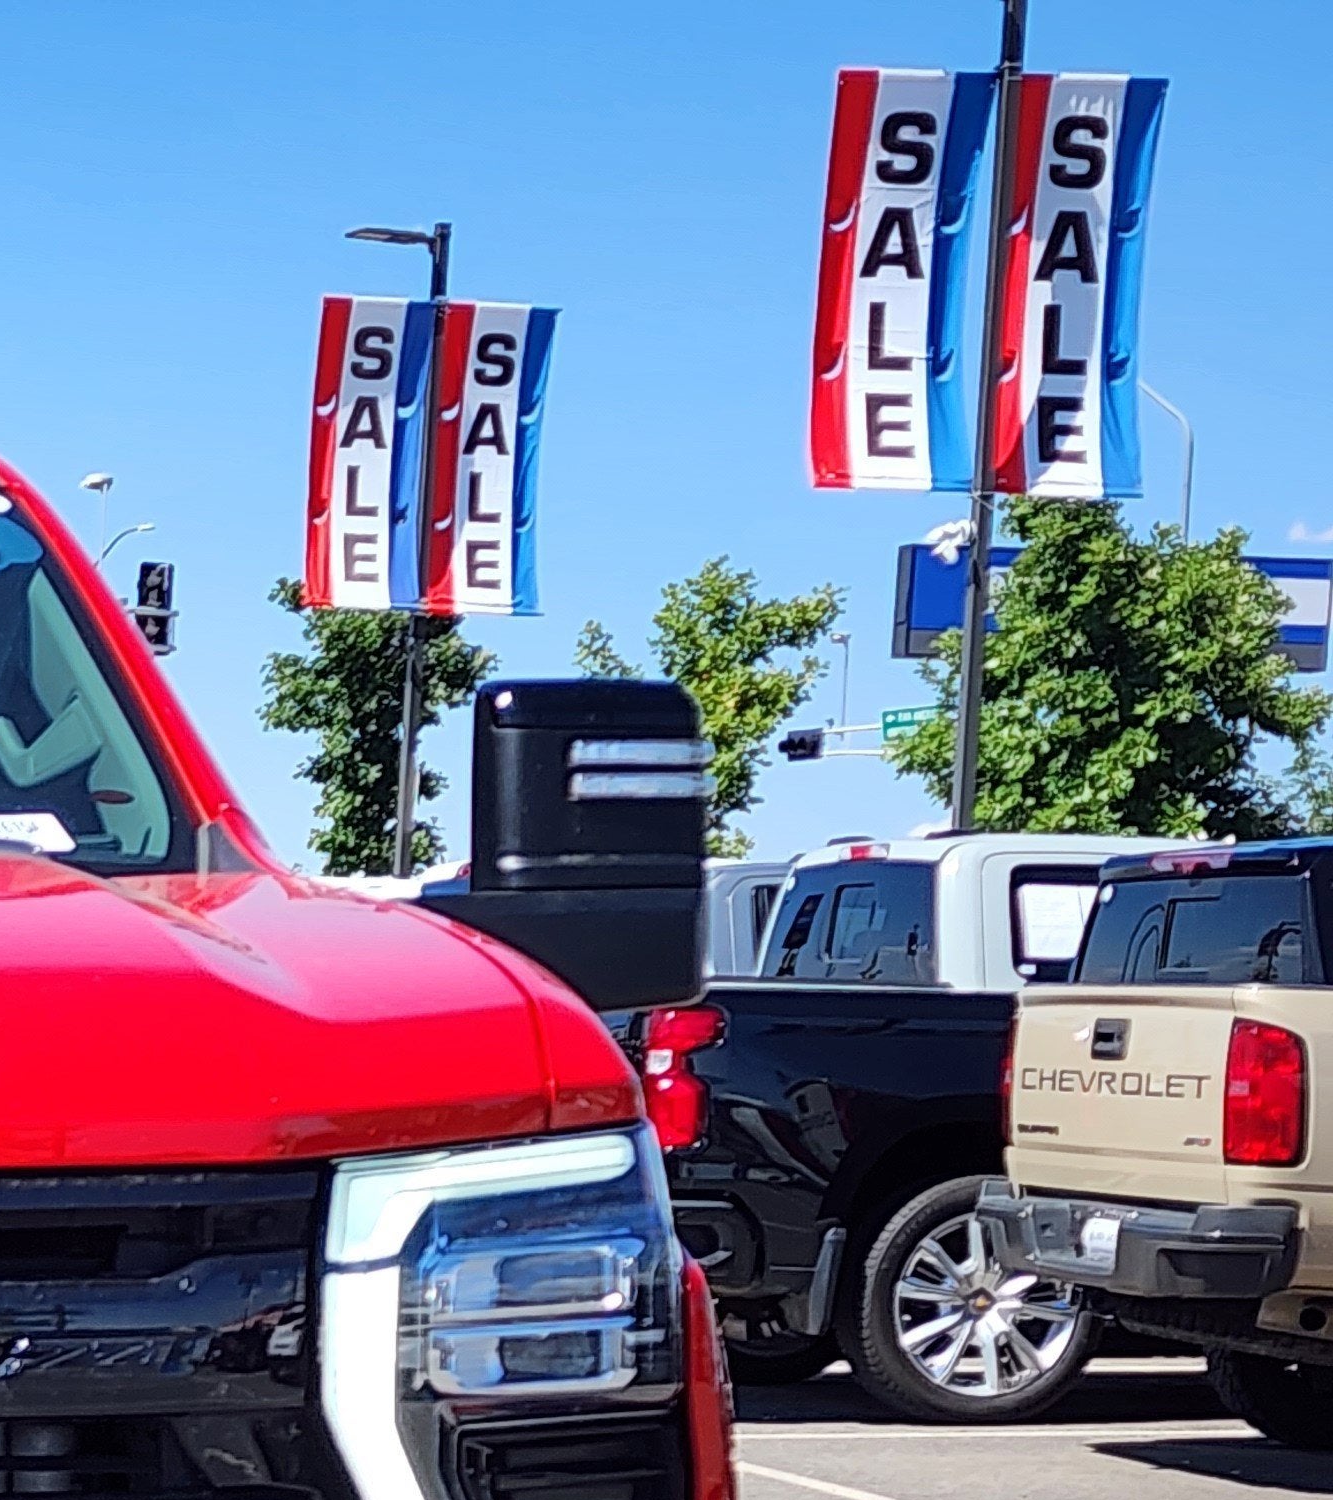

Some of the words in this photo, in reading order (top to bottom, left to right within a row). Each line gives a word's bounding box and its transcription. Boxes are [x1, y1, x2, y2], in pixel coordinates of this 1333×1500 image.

[859, 110, 937, 458] SALE
[1033, 115, 1109, 464] SALE
[338, 325, 395, 583] SALE
[462, 332, 518, 590] SALE
[1021, 1067, 1212, 1099] CHEVROLET
